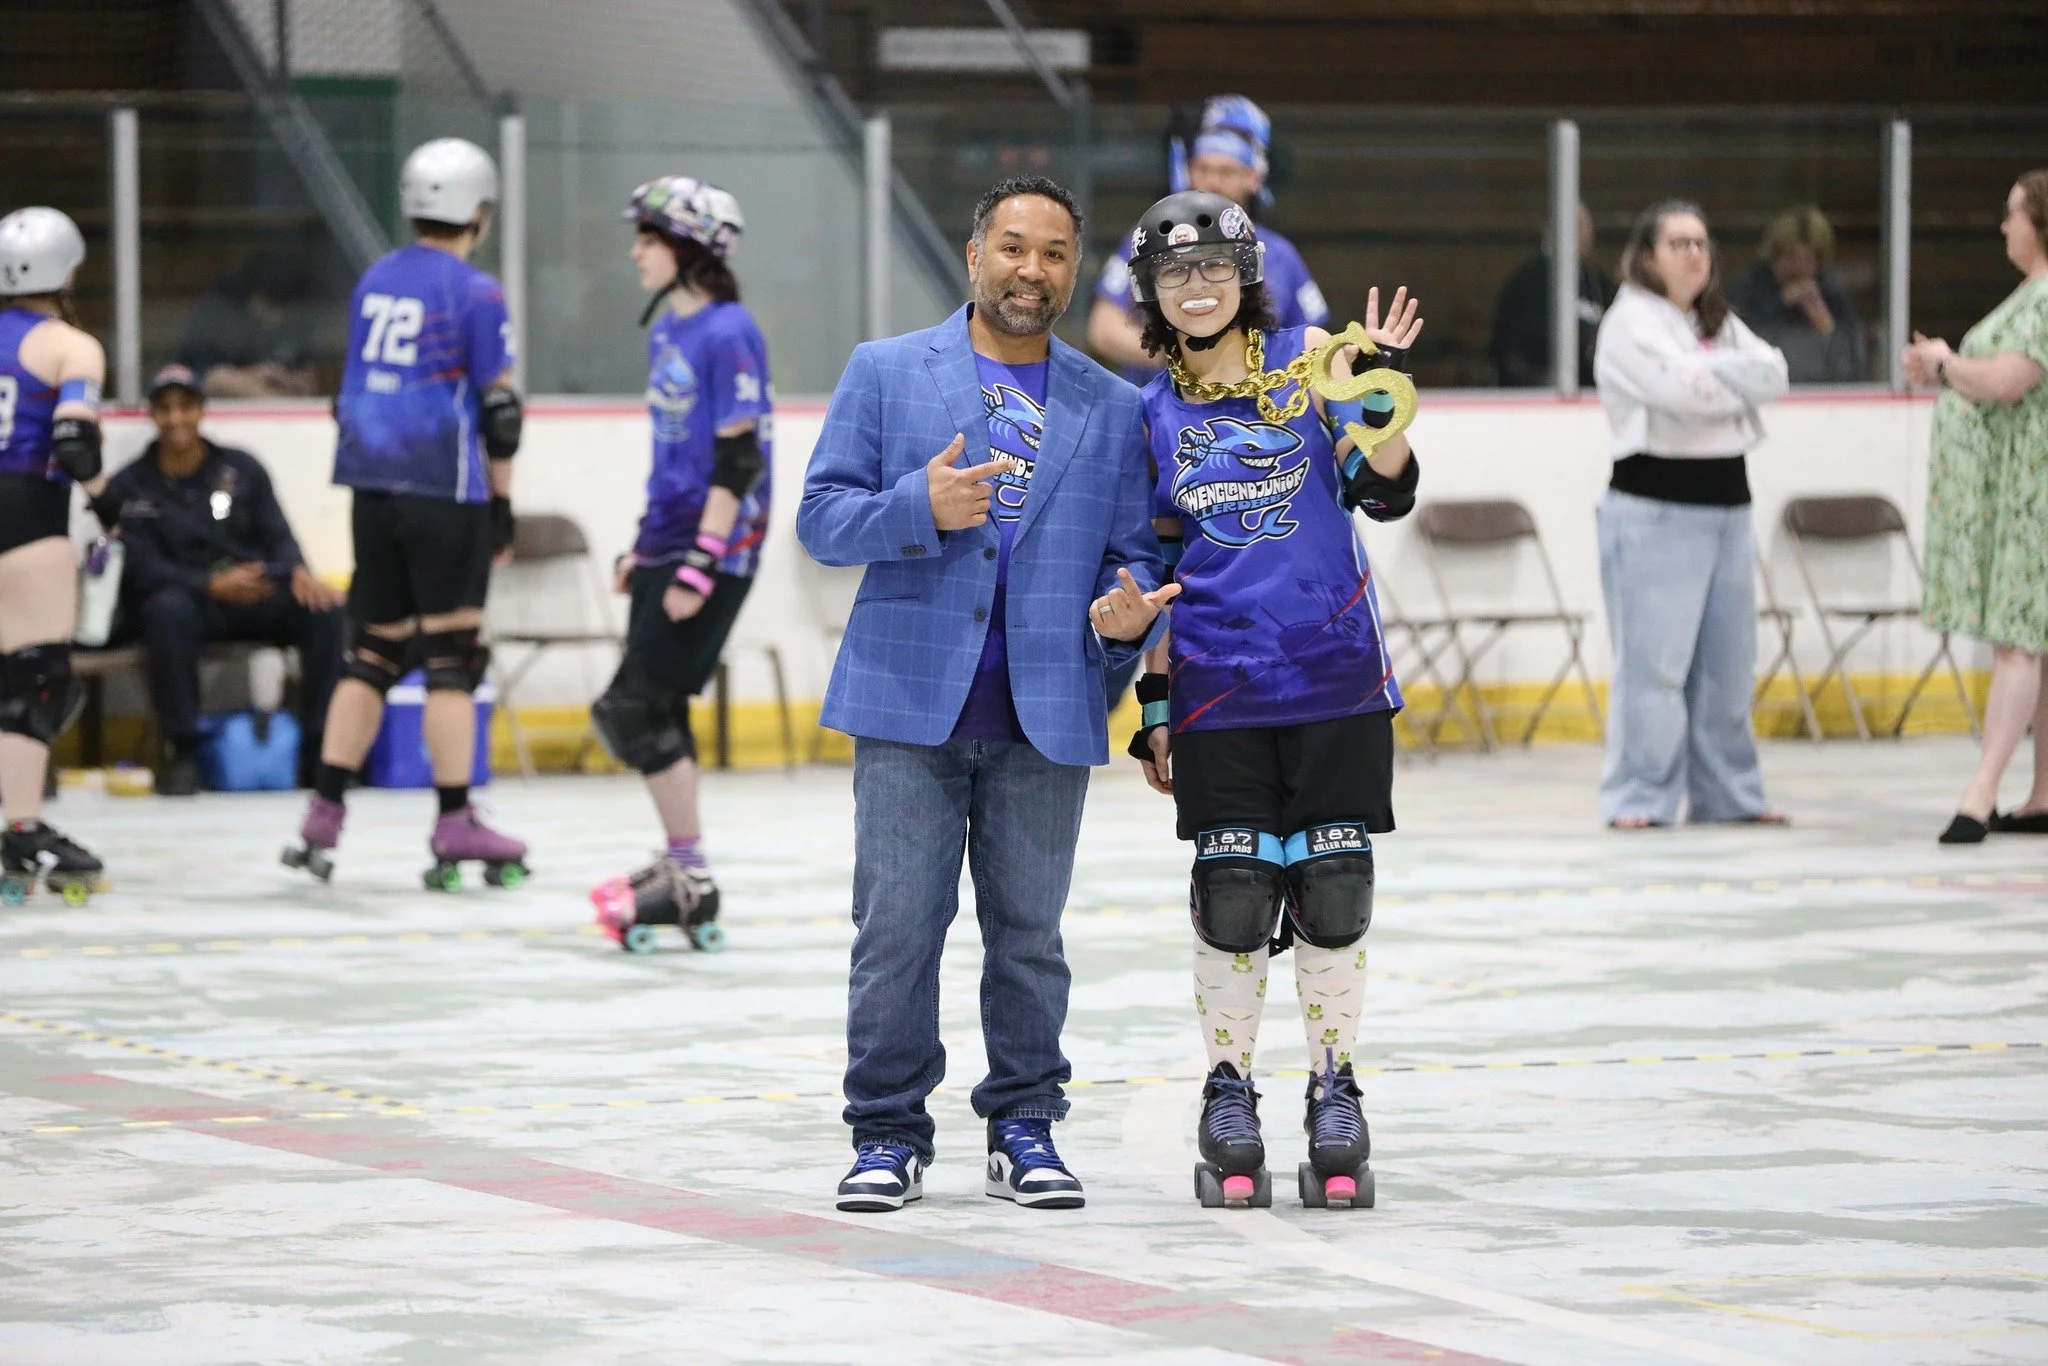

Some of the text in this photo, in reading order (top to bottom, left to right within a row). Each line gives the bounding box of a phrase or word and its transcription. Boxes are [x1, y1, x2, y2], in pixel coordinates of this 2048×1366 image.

[361, 293, 425, 367] 72
[1312, 321, 1419, 458] S
[1208, 832, 1252, 846] 187
[1313, 828, 1357, 843] 187
[1203, 844, 1252, 856] KILLER PADS
[1313, 840, 1362, 852] KILLER PADS
